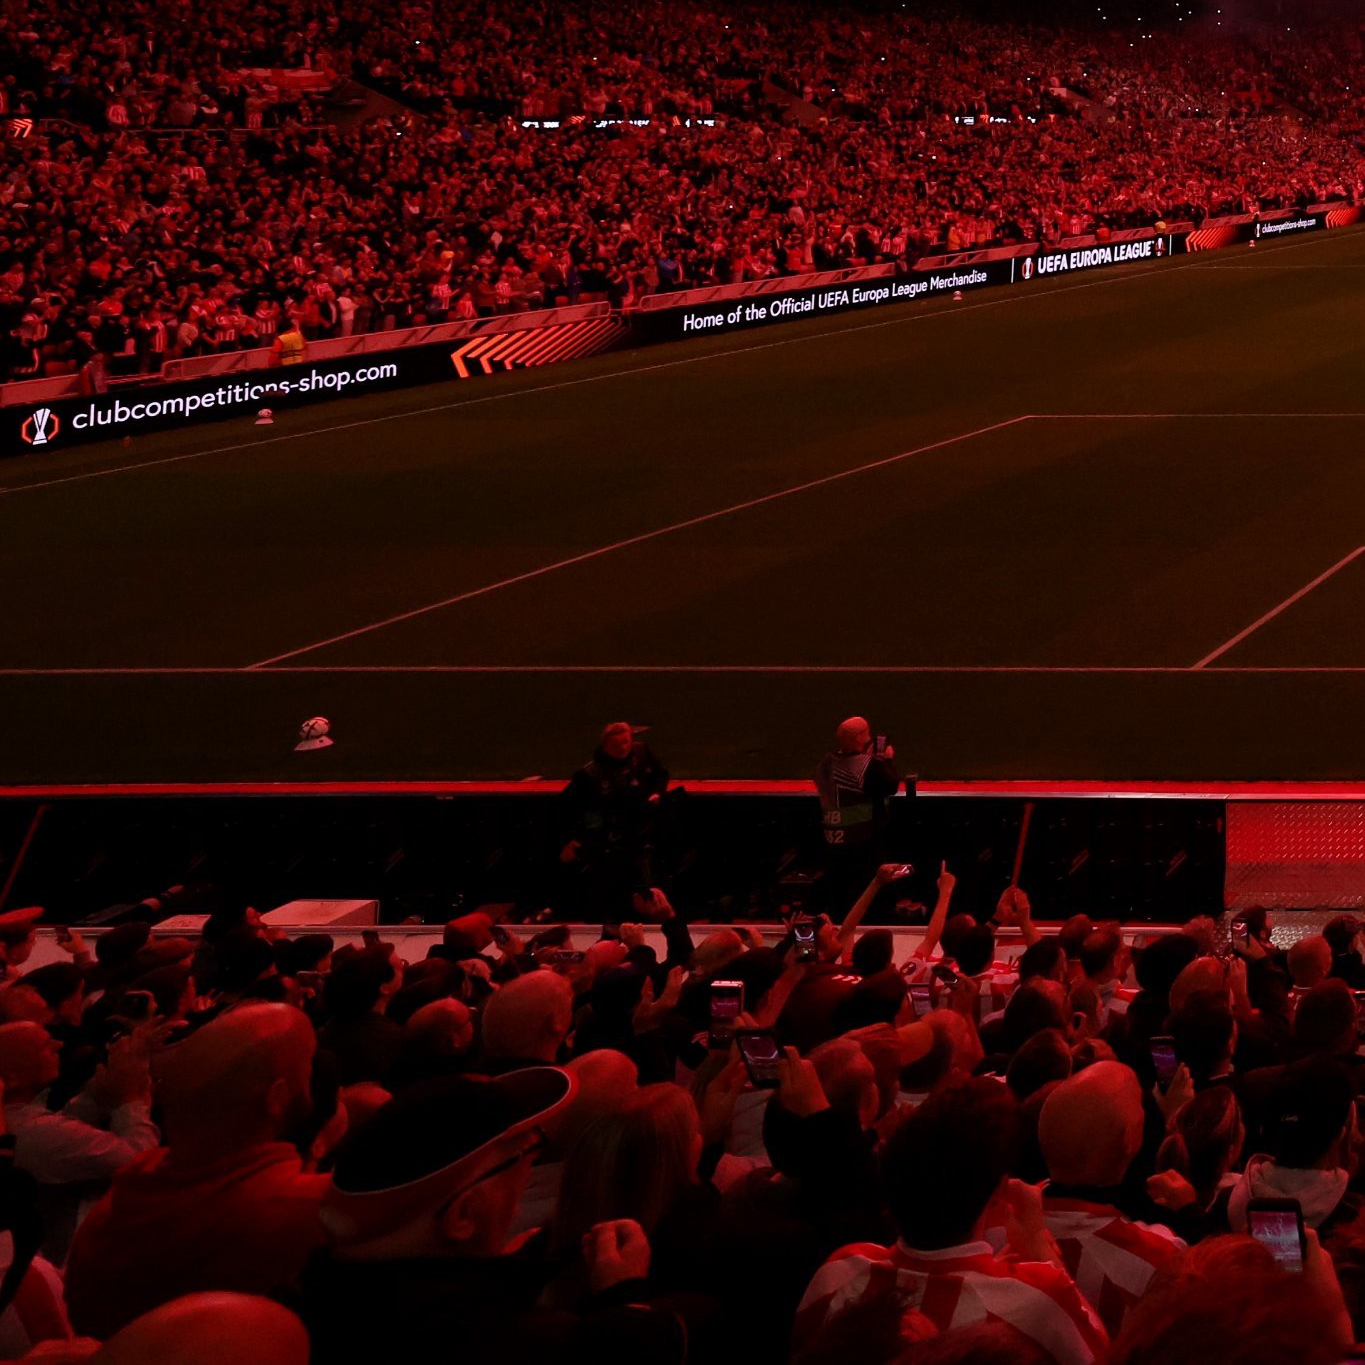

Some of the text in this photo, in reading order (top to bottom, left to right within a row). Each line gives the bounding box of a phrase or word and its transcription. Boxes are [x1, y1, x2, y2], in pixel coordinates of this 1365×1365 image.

[1037, 241, 1153, 274] UEFA EUROPA LEAGUE
[683, 269, 988, 332] Home of the Official UEFA Europa League Merchandise
[72, 363, 397, 429] clubcompetitions-shop.com
